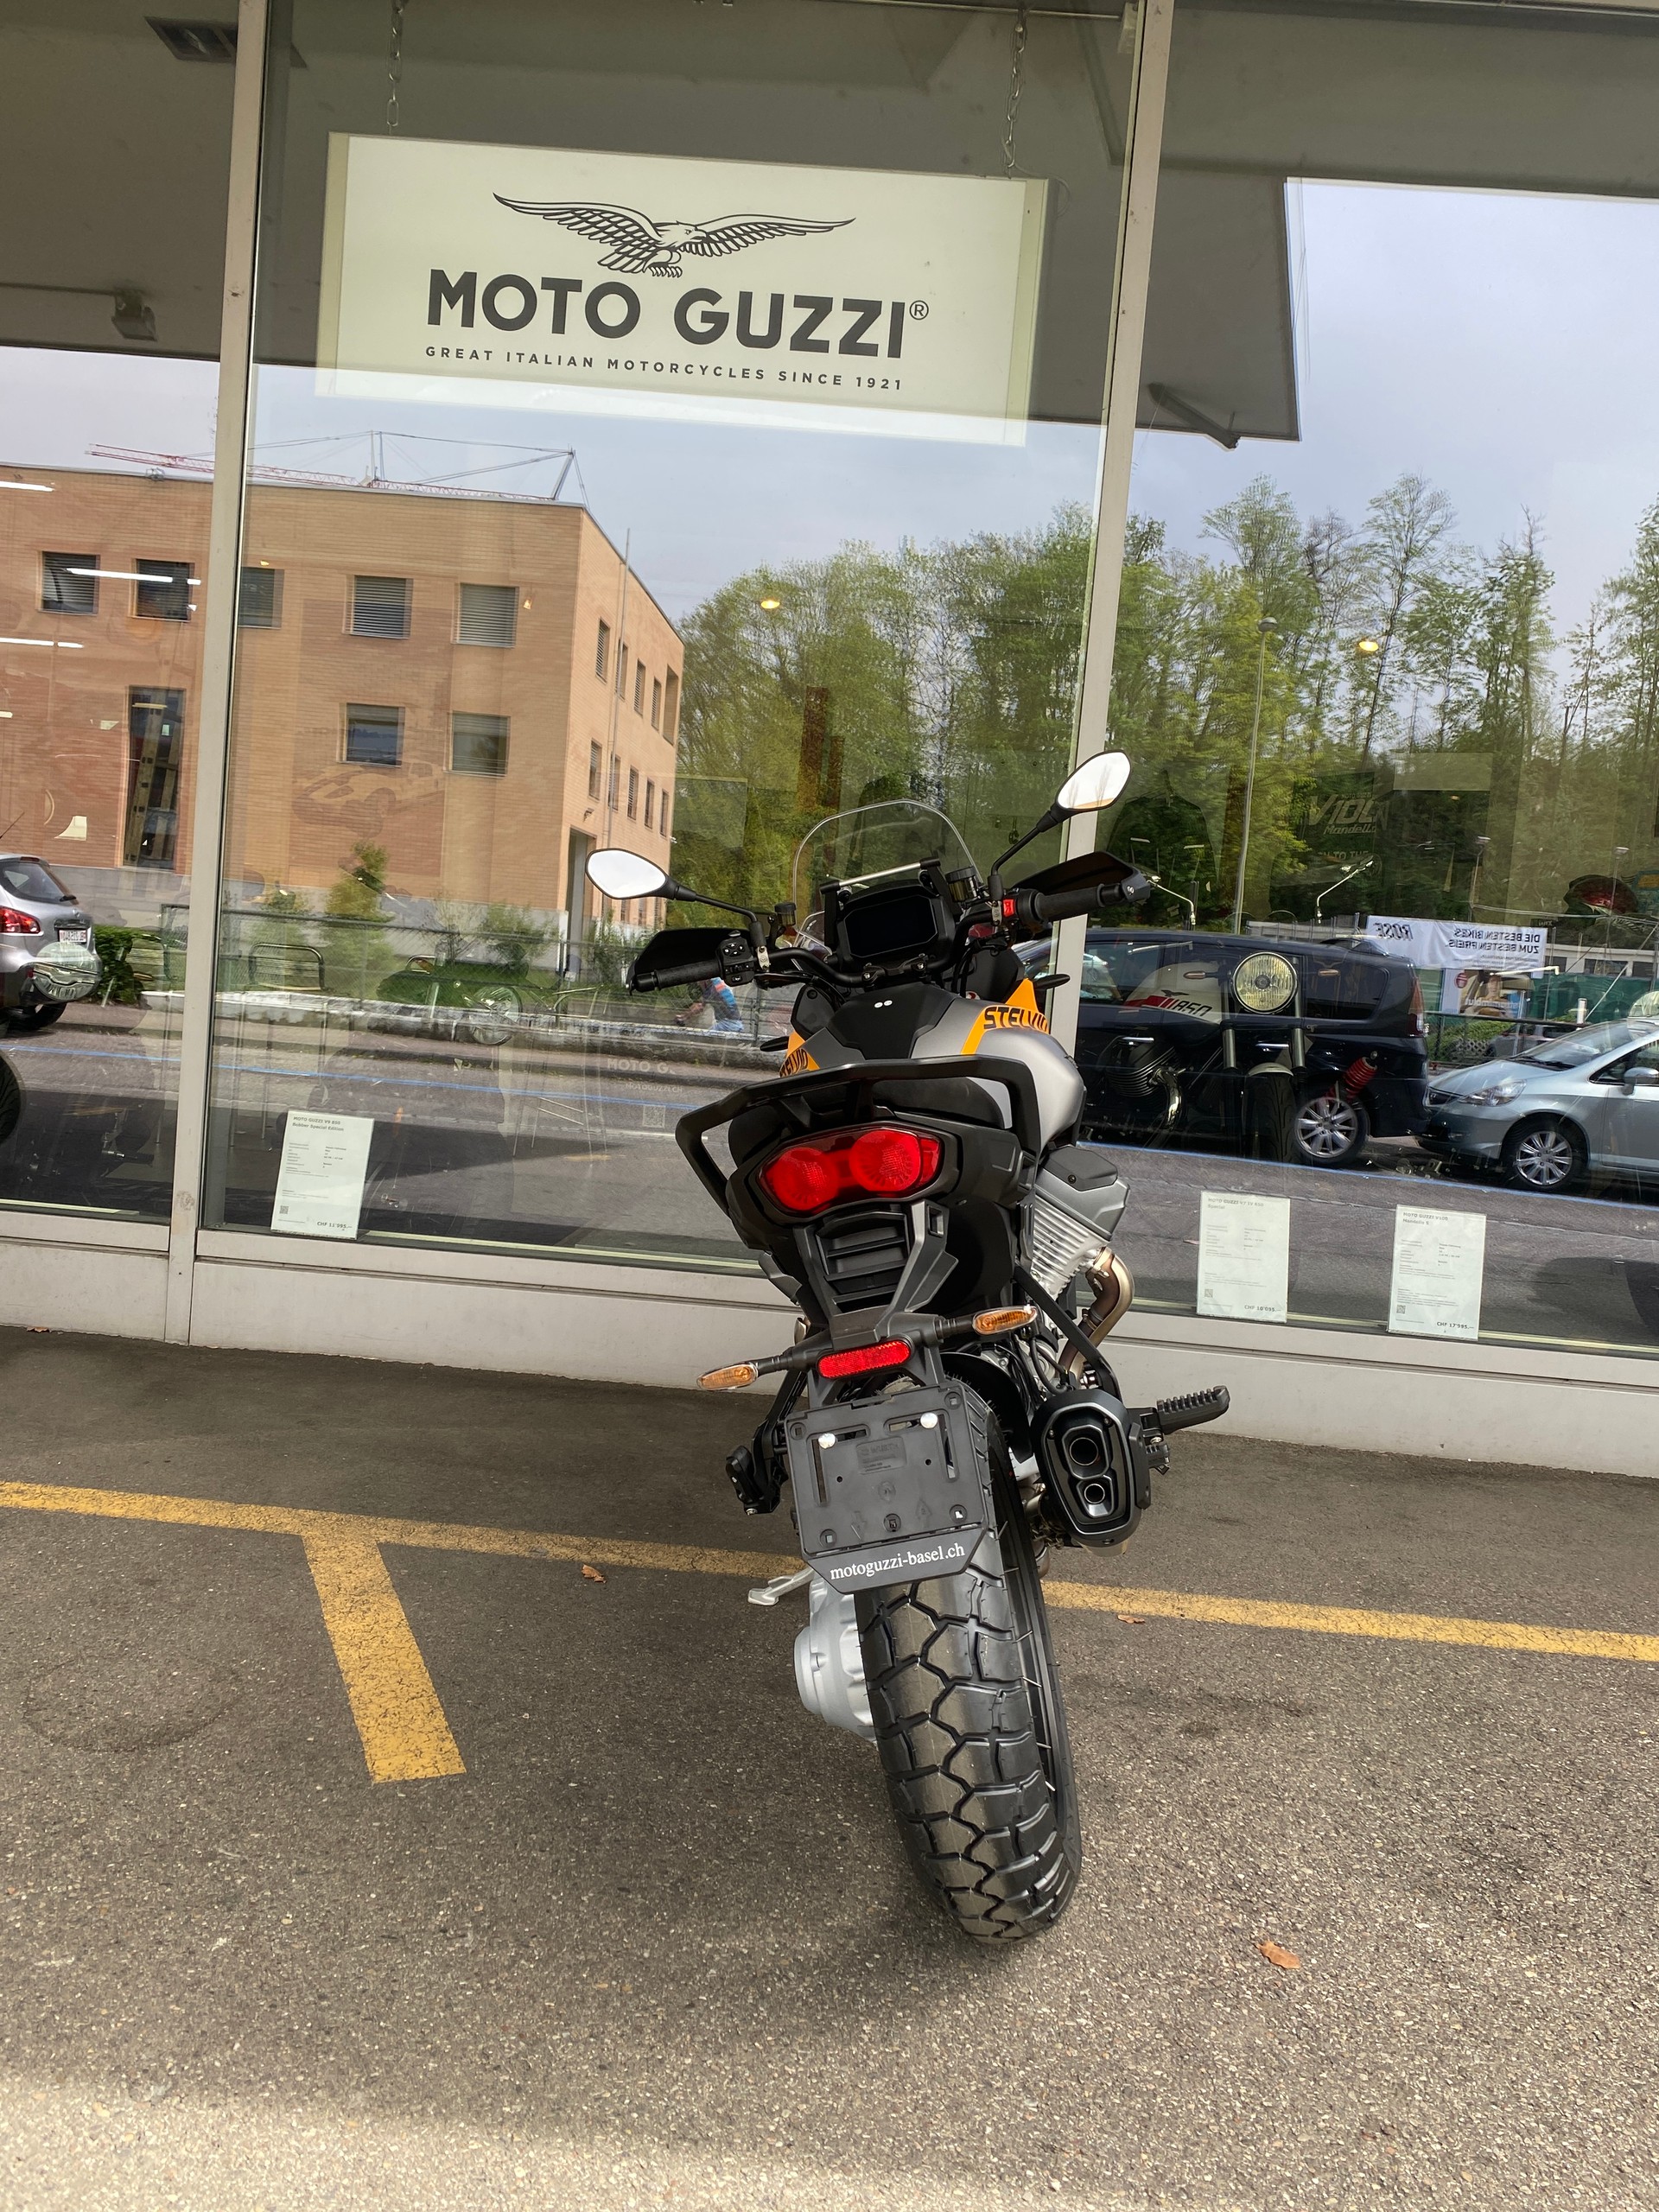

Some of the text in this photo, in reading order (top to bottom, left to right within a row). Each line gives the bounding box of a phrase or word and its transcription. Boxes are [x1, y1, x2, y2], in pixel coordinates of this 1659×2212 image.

[427, 269, 906, 359] MOTO GUZZI
[425, 346, 900, 391] GREAT ITALIAN MOTORCYCLES SINCE 1921
[983, 1006, 1049, 1033] STELVIO
[607, 1058, 652, 1072] MOTO
[830, 1542, 966, 1580] motoguzzi-basel.ch
